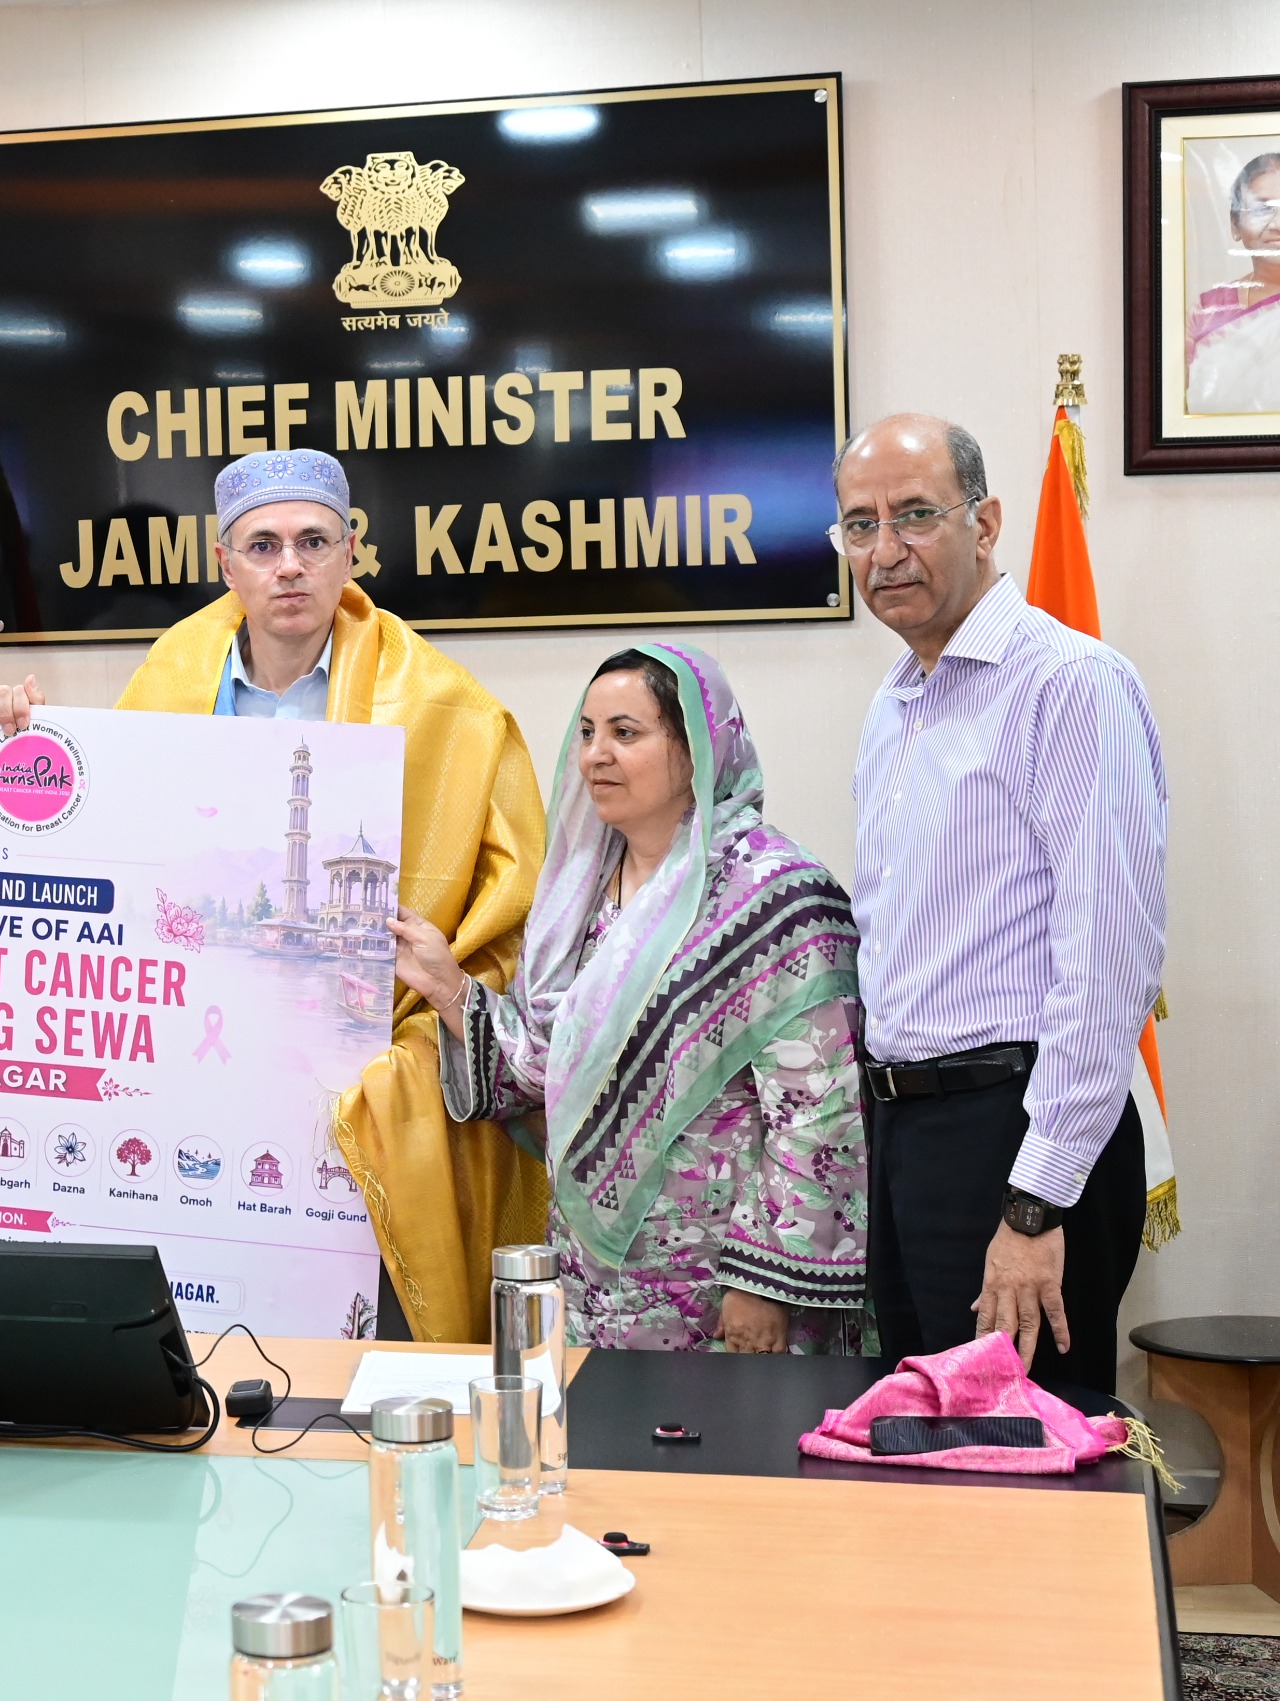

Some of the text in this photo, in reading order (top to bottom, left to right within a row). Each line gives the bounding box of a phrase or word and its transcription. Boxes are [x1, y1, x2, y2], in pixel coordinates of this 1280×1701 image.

[340, 307, 450, 331] सत्यमेव जयते
[107, 367, 687, 462] CHIEF MINISTER
[59, 515, 220, 589] JAM
[414, 494, 758, 576] KASHMIR
[32, 723, 64, 740] Women
[63, 737, 85, 777] Wellness
[2, 763, 33, 773] India
[22, 823, 34, 832] for
[36, 817, 63, 832] Breast
[61, 793, 83, 820] Cancer
[32, 882, 98, 907] LAUNCH
[32, 917, 69, 941] OF
[76, 921, 124, 946] AAI
[24, 949, 187, 1007] CANCER
[35, 1006, 155, 1064] SEWA
[52, 1182, 86, 1195] Dazna
[109, 1187, 159, 1202] Kanihana
[179, 1195, 213, 1208] Omoh
[237, 1200, 292, 1215] Hat Barah
[305, 1207, 367, 1223] Gogji Gund
